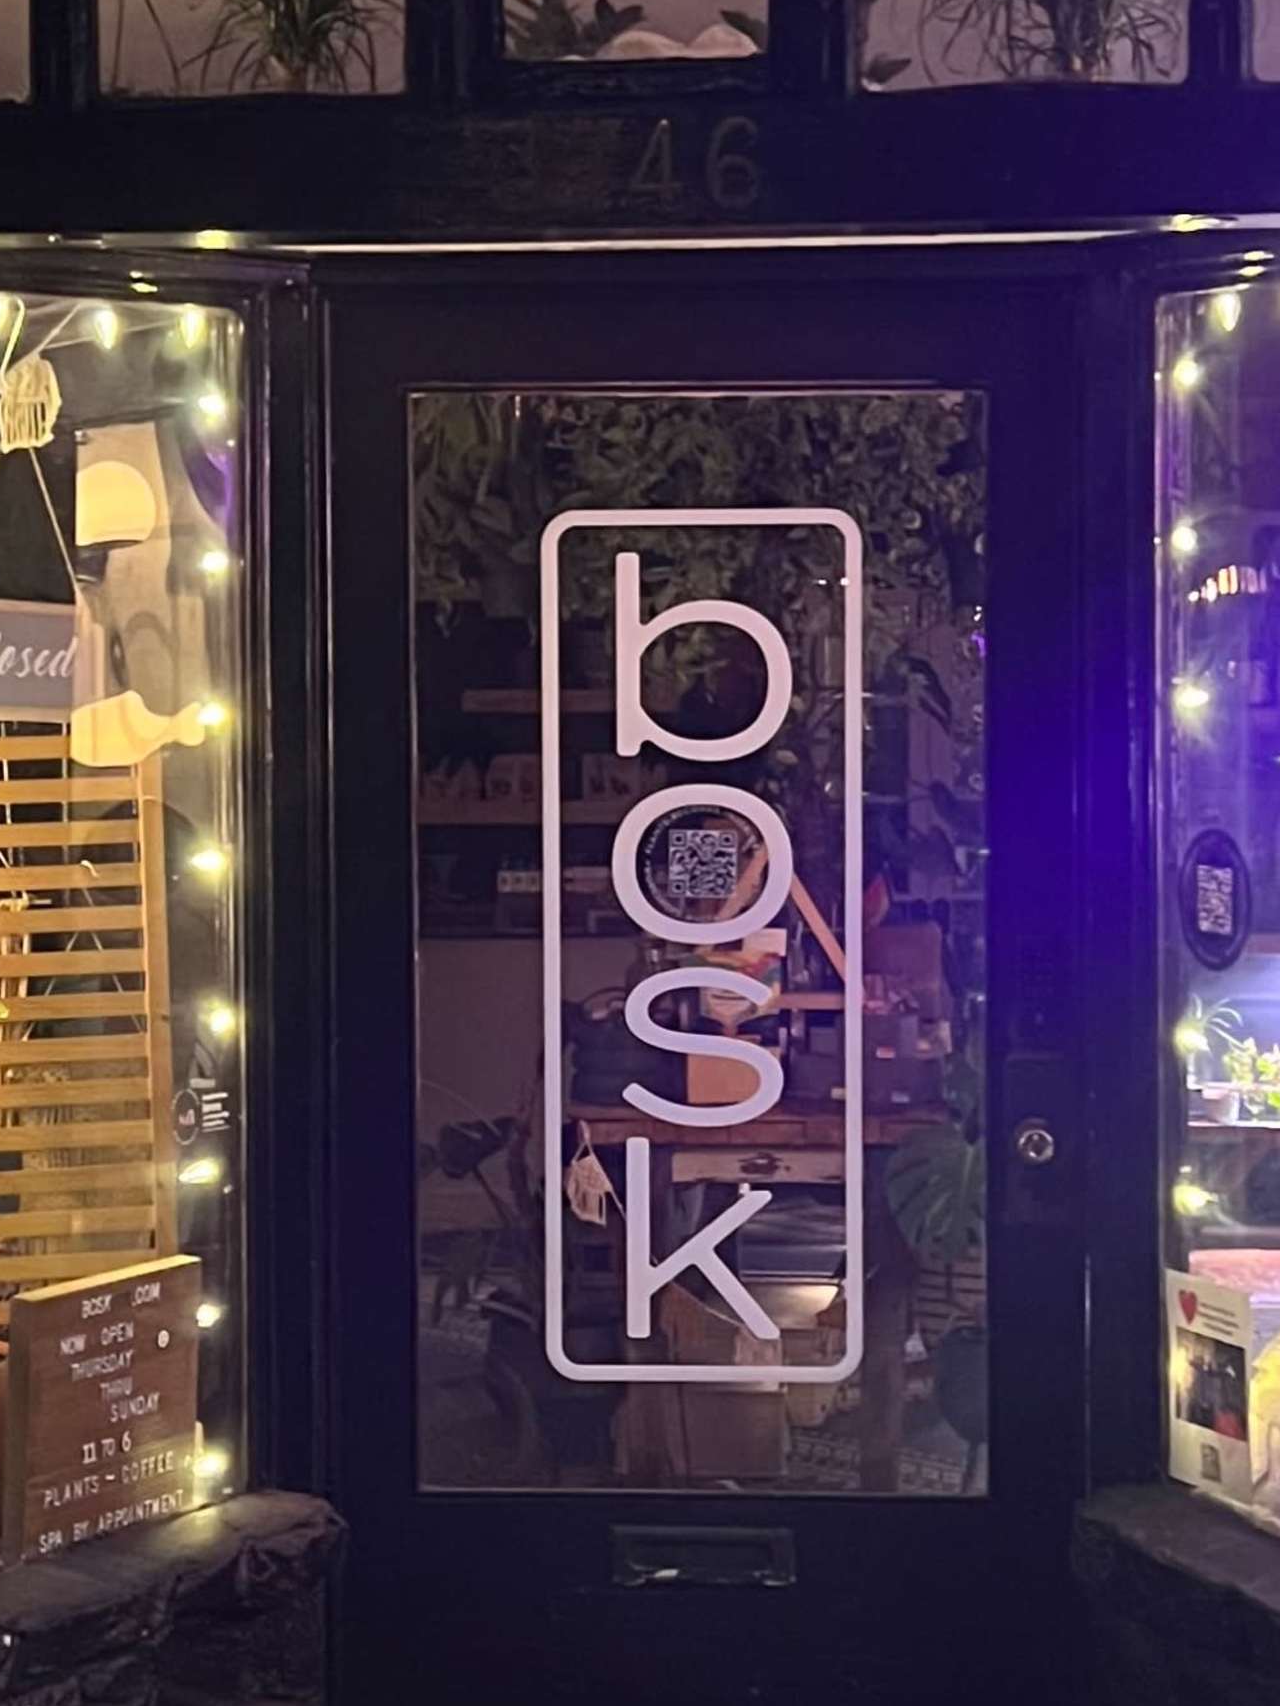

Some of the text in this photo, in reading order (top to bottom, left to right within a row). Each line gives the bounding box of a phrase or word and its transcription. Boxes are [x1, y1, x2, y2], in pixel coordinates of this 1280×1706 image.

[611, 551, 795, 1340] bosk
[59, 1321, 134, 1356] NOW OPEN
[70, 1349, 135, 1382] THURSDAY
[109, 1391, 161, 1423] SUNDAY
[101, 1437, 116, 1457] TO
[121, 1430, 132, 1453] 6
[43, 1474, 100, 1509] PLANTS
[120, 1450, 174, 1484] COFFEE
[38, 1488, 184, 1554] SPA BY APPOINTMENT
